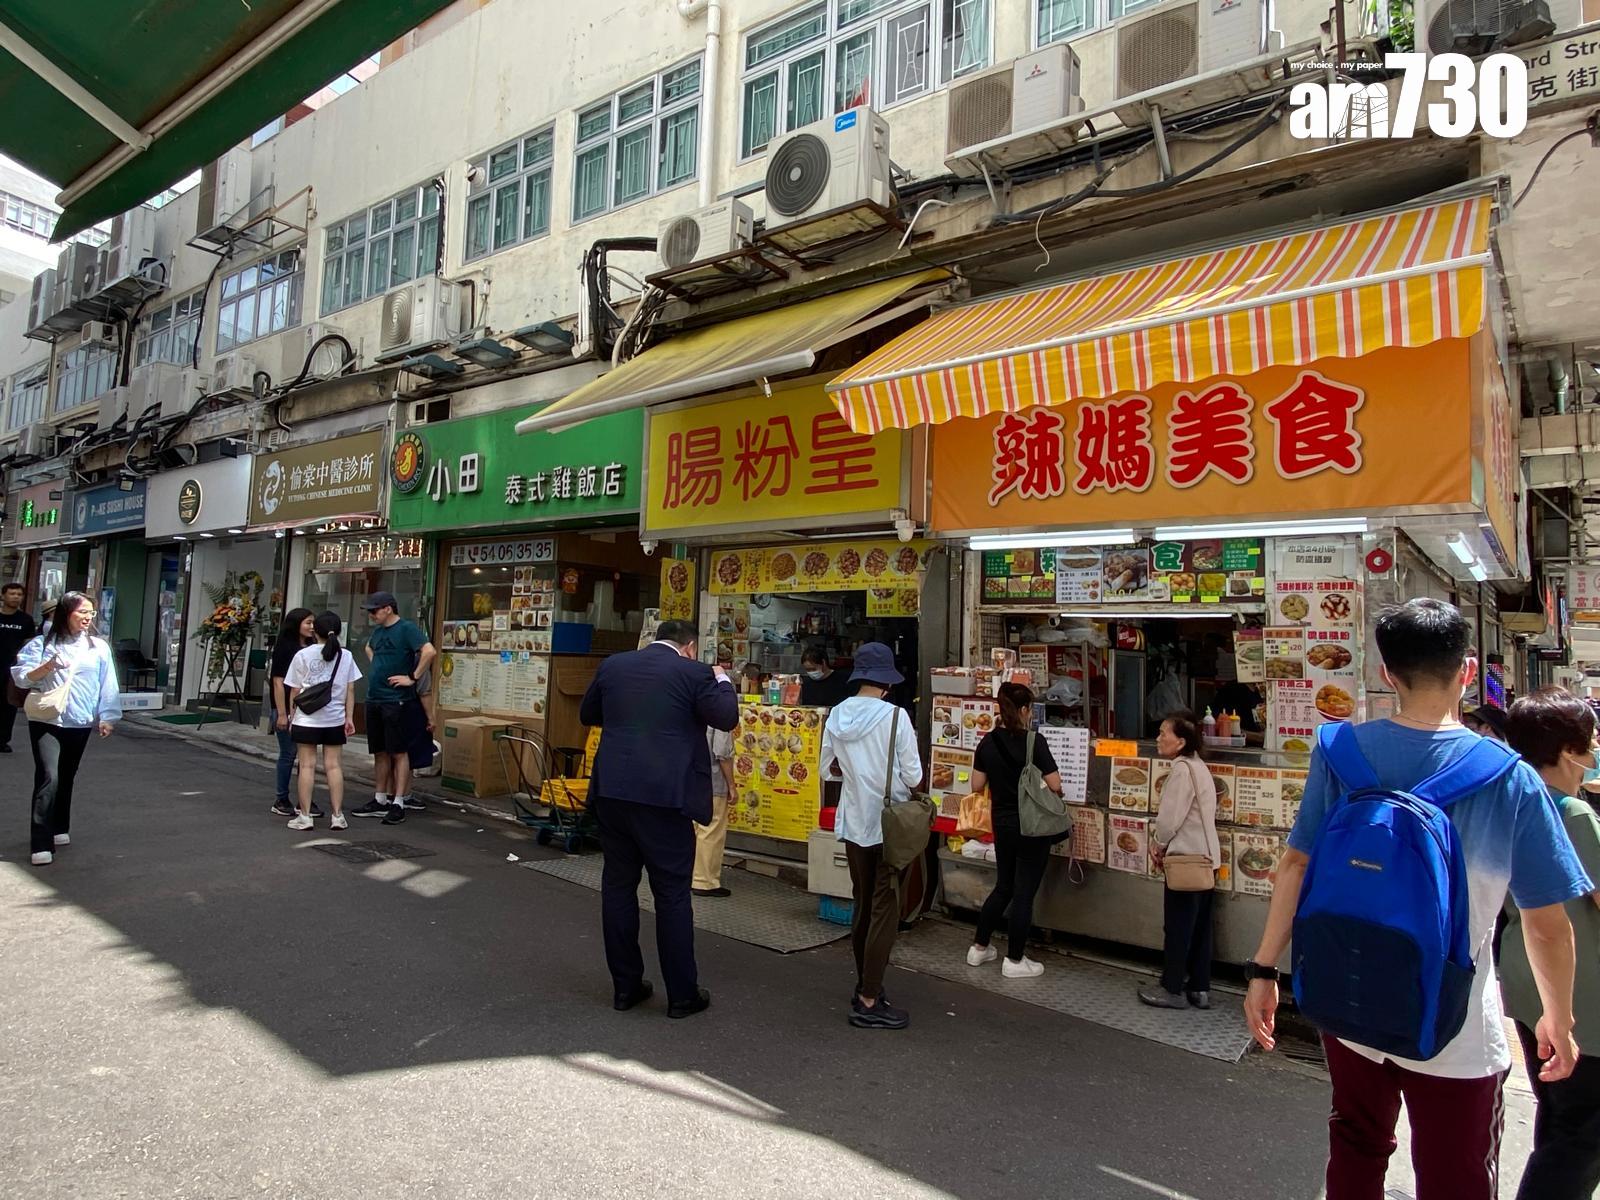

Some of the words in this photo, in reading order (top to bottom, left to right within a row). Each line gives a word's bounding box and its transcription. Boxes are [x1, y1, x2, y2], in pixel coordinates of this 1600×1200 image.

[1564, 40, 1600, 59] Str
[988, 371, 1364, 505] 辣媽美食
[662, 411, 880, 510] 腸粉皇
[327, 486, 354, 498] MEDICINE
[354, 483, 373, 494] CLINIC
[426, 453, 479, 502] 小田
[504, 462, 622, 505] 泰式雞飯店
[124, 495, 144, 510] HOUSE
